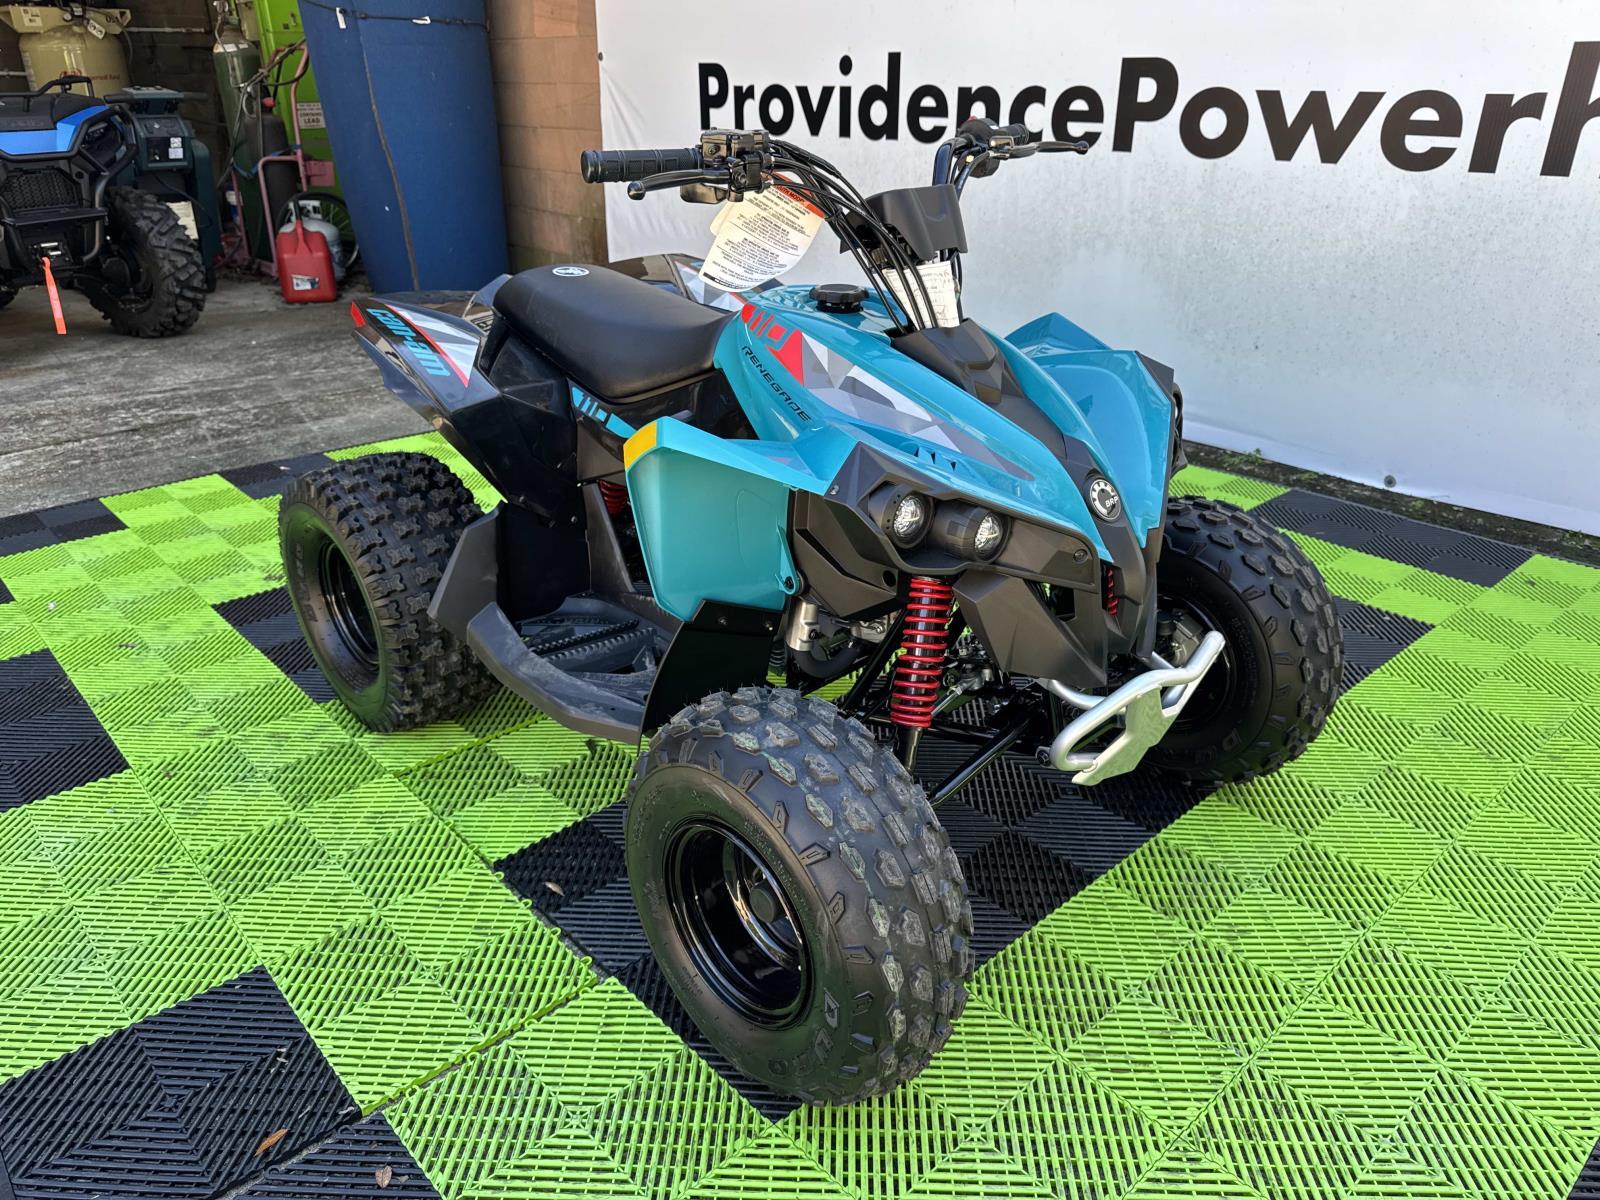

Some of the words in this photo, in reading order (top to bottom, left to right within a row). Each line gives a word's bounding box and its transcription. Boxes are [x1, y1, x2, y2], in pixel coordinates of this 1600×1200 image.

[366, 308, 451, 376] can-am
[741, 345, 812, 422] RENEGADE
[1105, 496, 1119, 507] BRP
